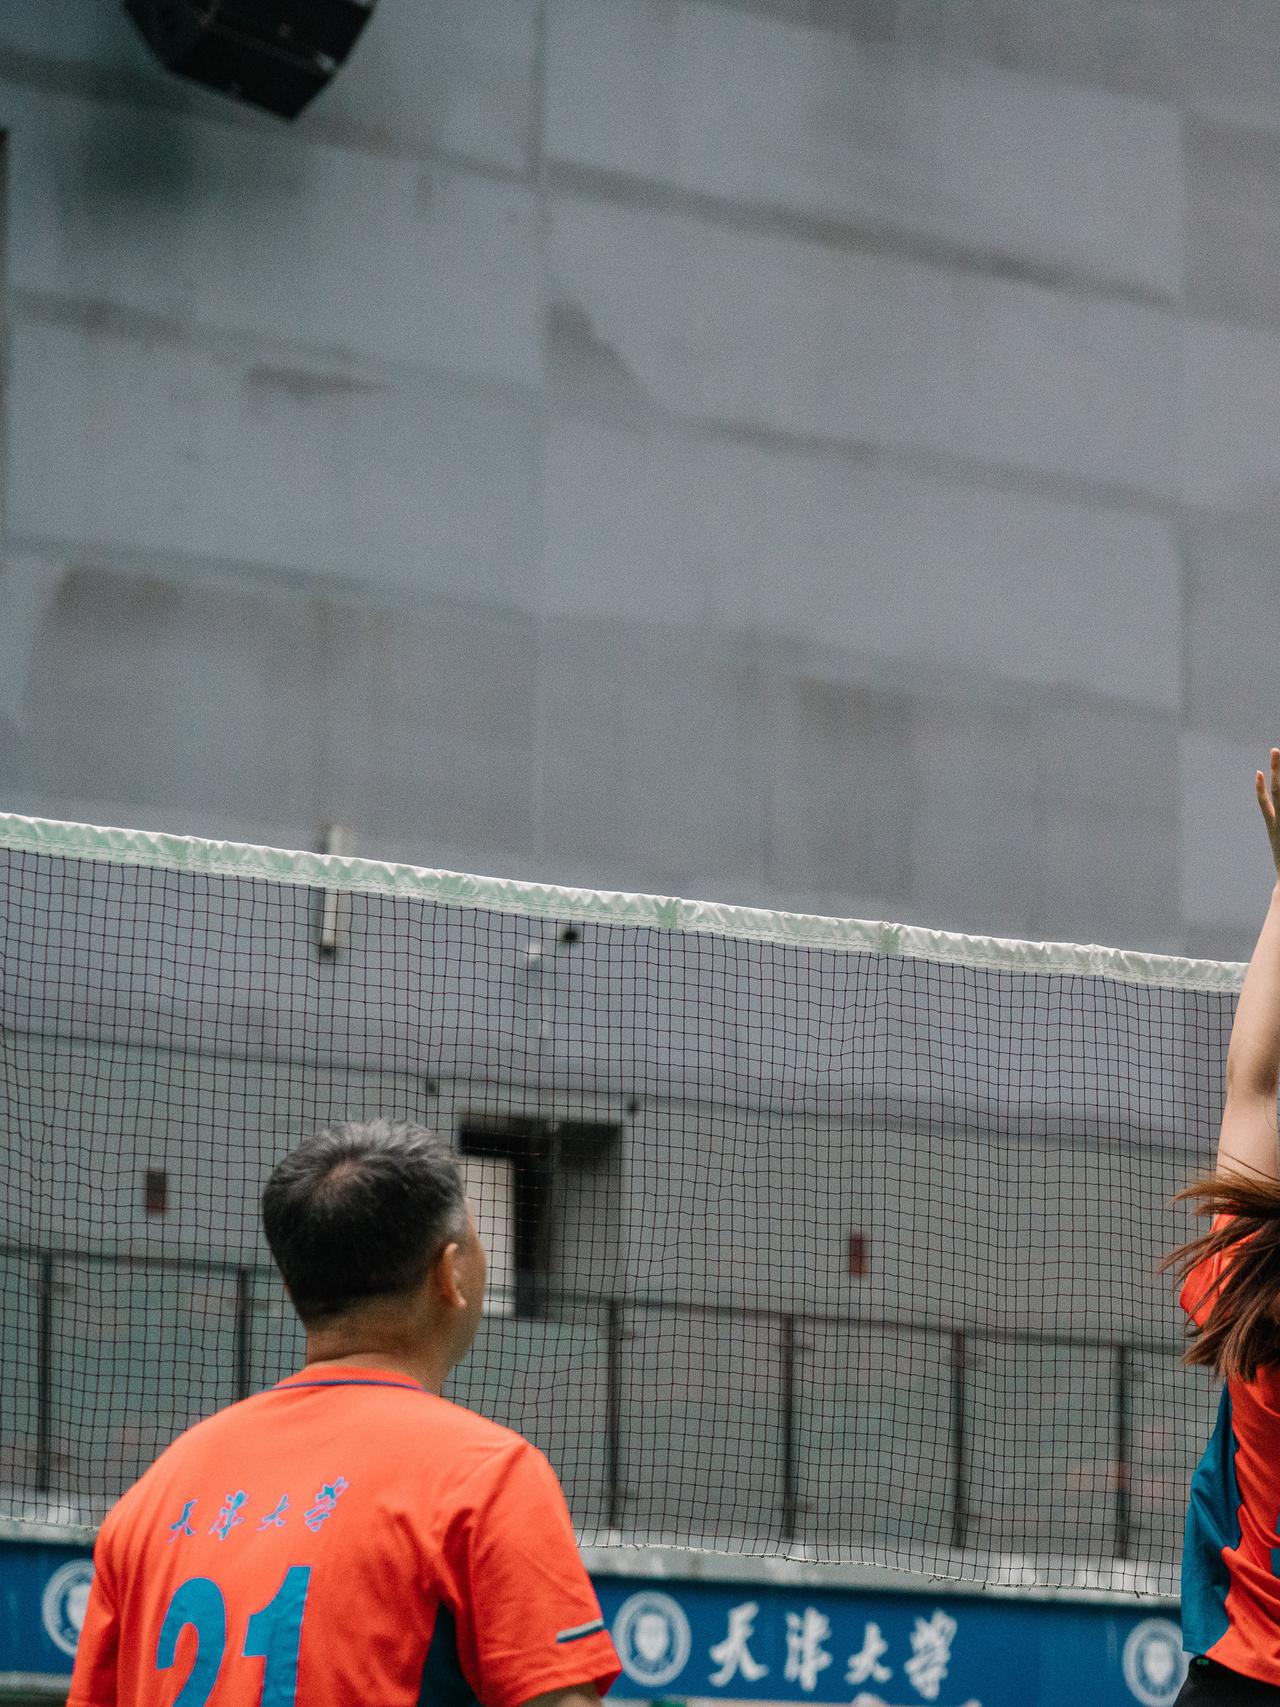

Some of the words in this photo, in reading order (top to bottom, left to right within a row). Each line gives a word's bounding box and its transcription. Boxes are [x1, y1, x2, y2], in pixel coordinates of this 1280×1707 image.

[166, 1476, 350, 1542] 天津大学
[155, 1564, 313, 1707] 21
[708, 1601, 958, 1699] 天津大学
